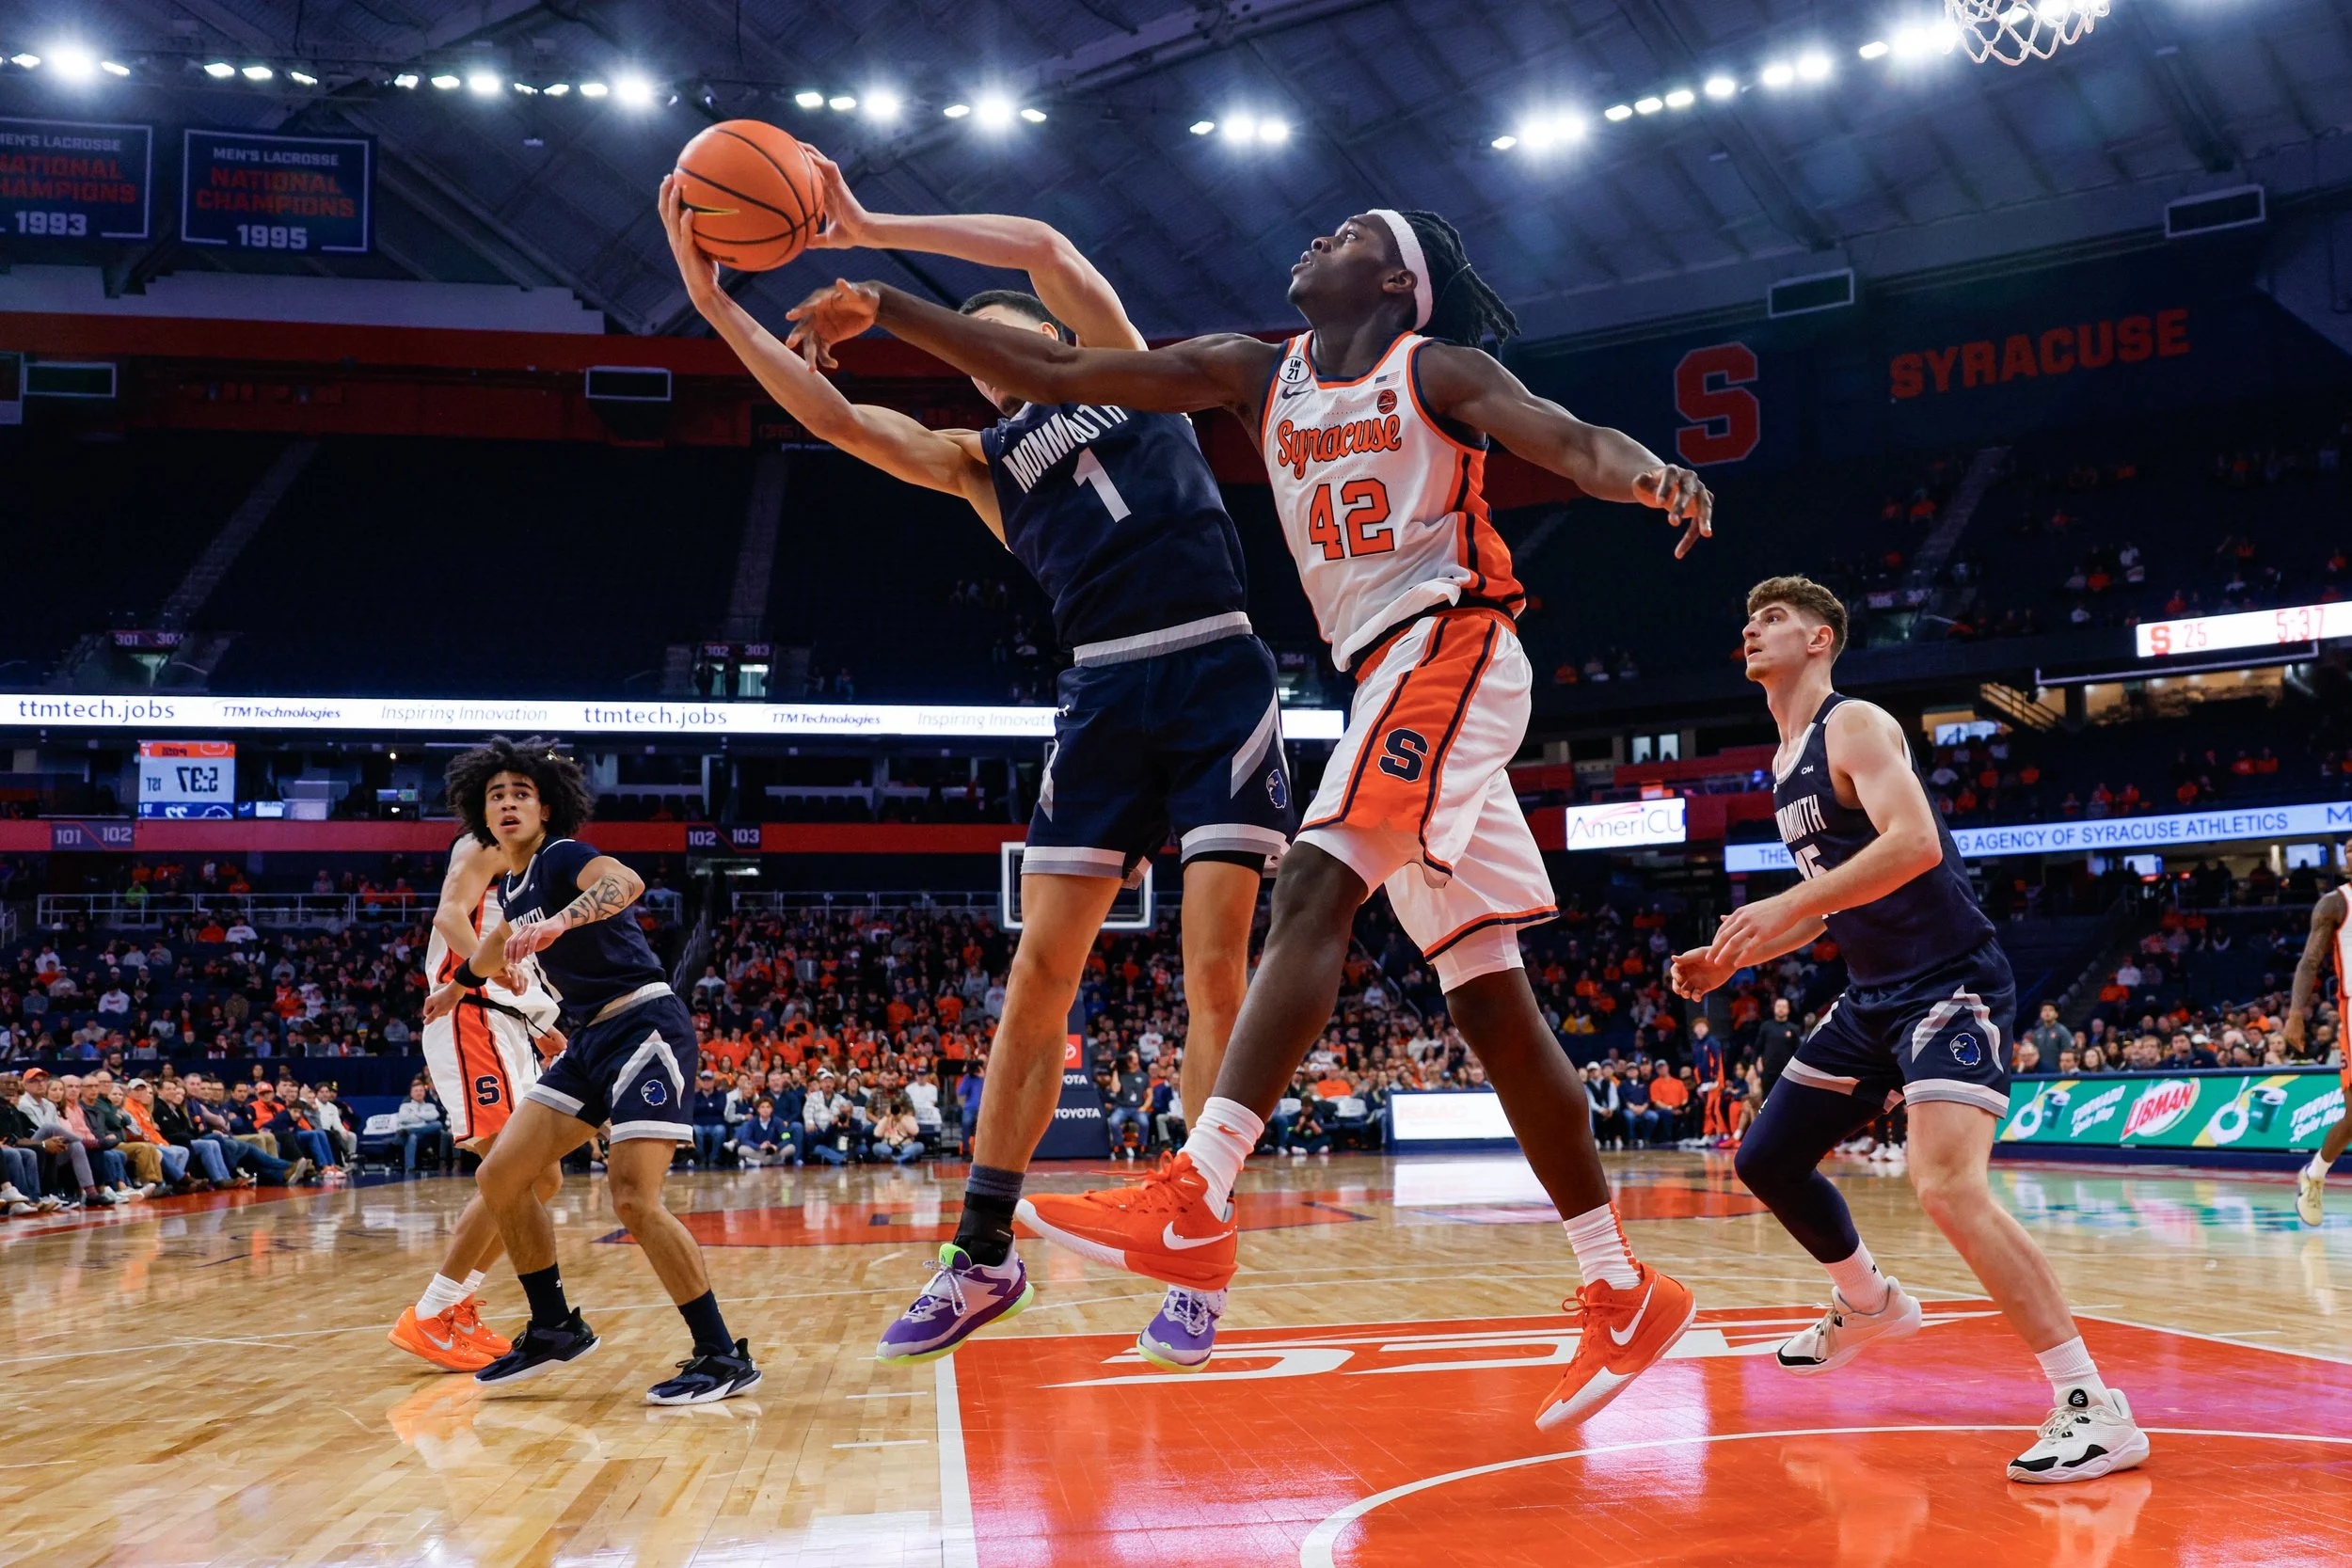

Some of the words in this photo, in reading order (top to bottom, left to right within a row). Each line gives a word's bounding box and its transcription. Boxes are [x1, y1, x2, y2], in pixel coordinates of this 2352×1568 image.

[43, 135, 121, 152] LACROSSE
[213, 147, 260, 163] MEN'S
[262, 149, 340, 166] LACROSSE
[210, 166, 342, 194] NATIONAL
[196, 188, 355, 218] CHAMPIONS
[15, 210, 87, 237] 1993
[236, 224, 309, 250] 1995
[1290, 359, 1301, 369] LM
[1890, 309, 2190, 400] SYRACUSE
[1287, 368, 1299, 381] 21
[1675, 341, 1760, 467] S
[1001, 404, 1129, 494] MONMOUTH
[1277, 414, 1402, 480] Syracuse
[1072, 447, 1132, 523] 1
[1309, 478, 1395, 561] 42
[114, 633, 139, 646] 301
[705, 645, 729, 657] 302
[744, 644, 770, 657] 303
[2151, 625, 2171, 655] S
[2184, 622, 2207, 648] 25
[18, 700, 176, 723] ttmtech.jobs
[223, 706, 252, 718] TTM
[253, 706, 342, 721] Technologies
[380, 705, 455, 722] Inspiring
[458, 705, 548, 721] Innovation
[584, 705, 728, 729] ttmtech.jobs
[771, 713, 799, 724] TTM
[800, 713, 882, 727] Technologies
[917, 711, 985, 729] Inspiring
[1377, 727, 1429, 783] S
[1801, 765, 1814, 775] CAA
[56, 829, 82, 844] 101
[102, 826, 133, 843] 102
[732, 828, 760, 844] 103
[1569, 809, 1686, 841] AmeriCU
[1758, 848, 1789, 864] THE
[1975, 830, 2047, 852] AGENCY
[2052, 827, 2076, 845] OF
[2081, 819, 2181, 844] SYRACUSE
[2185, 811, 2289, 836] ATHLETICS
[688, 831, 716, 847] 102
[474, 1075, 501, 1106] S
[1054, 1108, 1102, 1119] TOYOTA
[2120, 1083, 2195, 1141] LIBMAN
